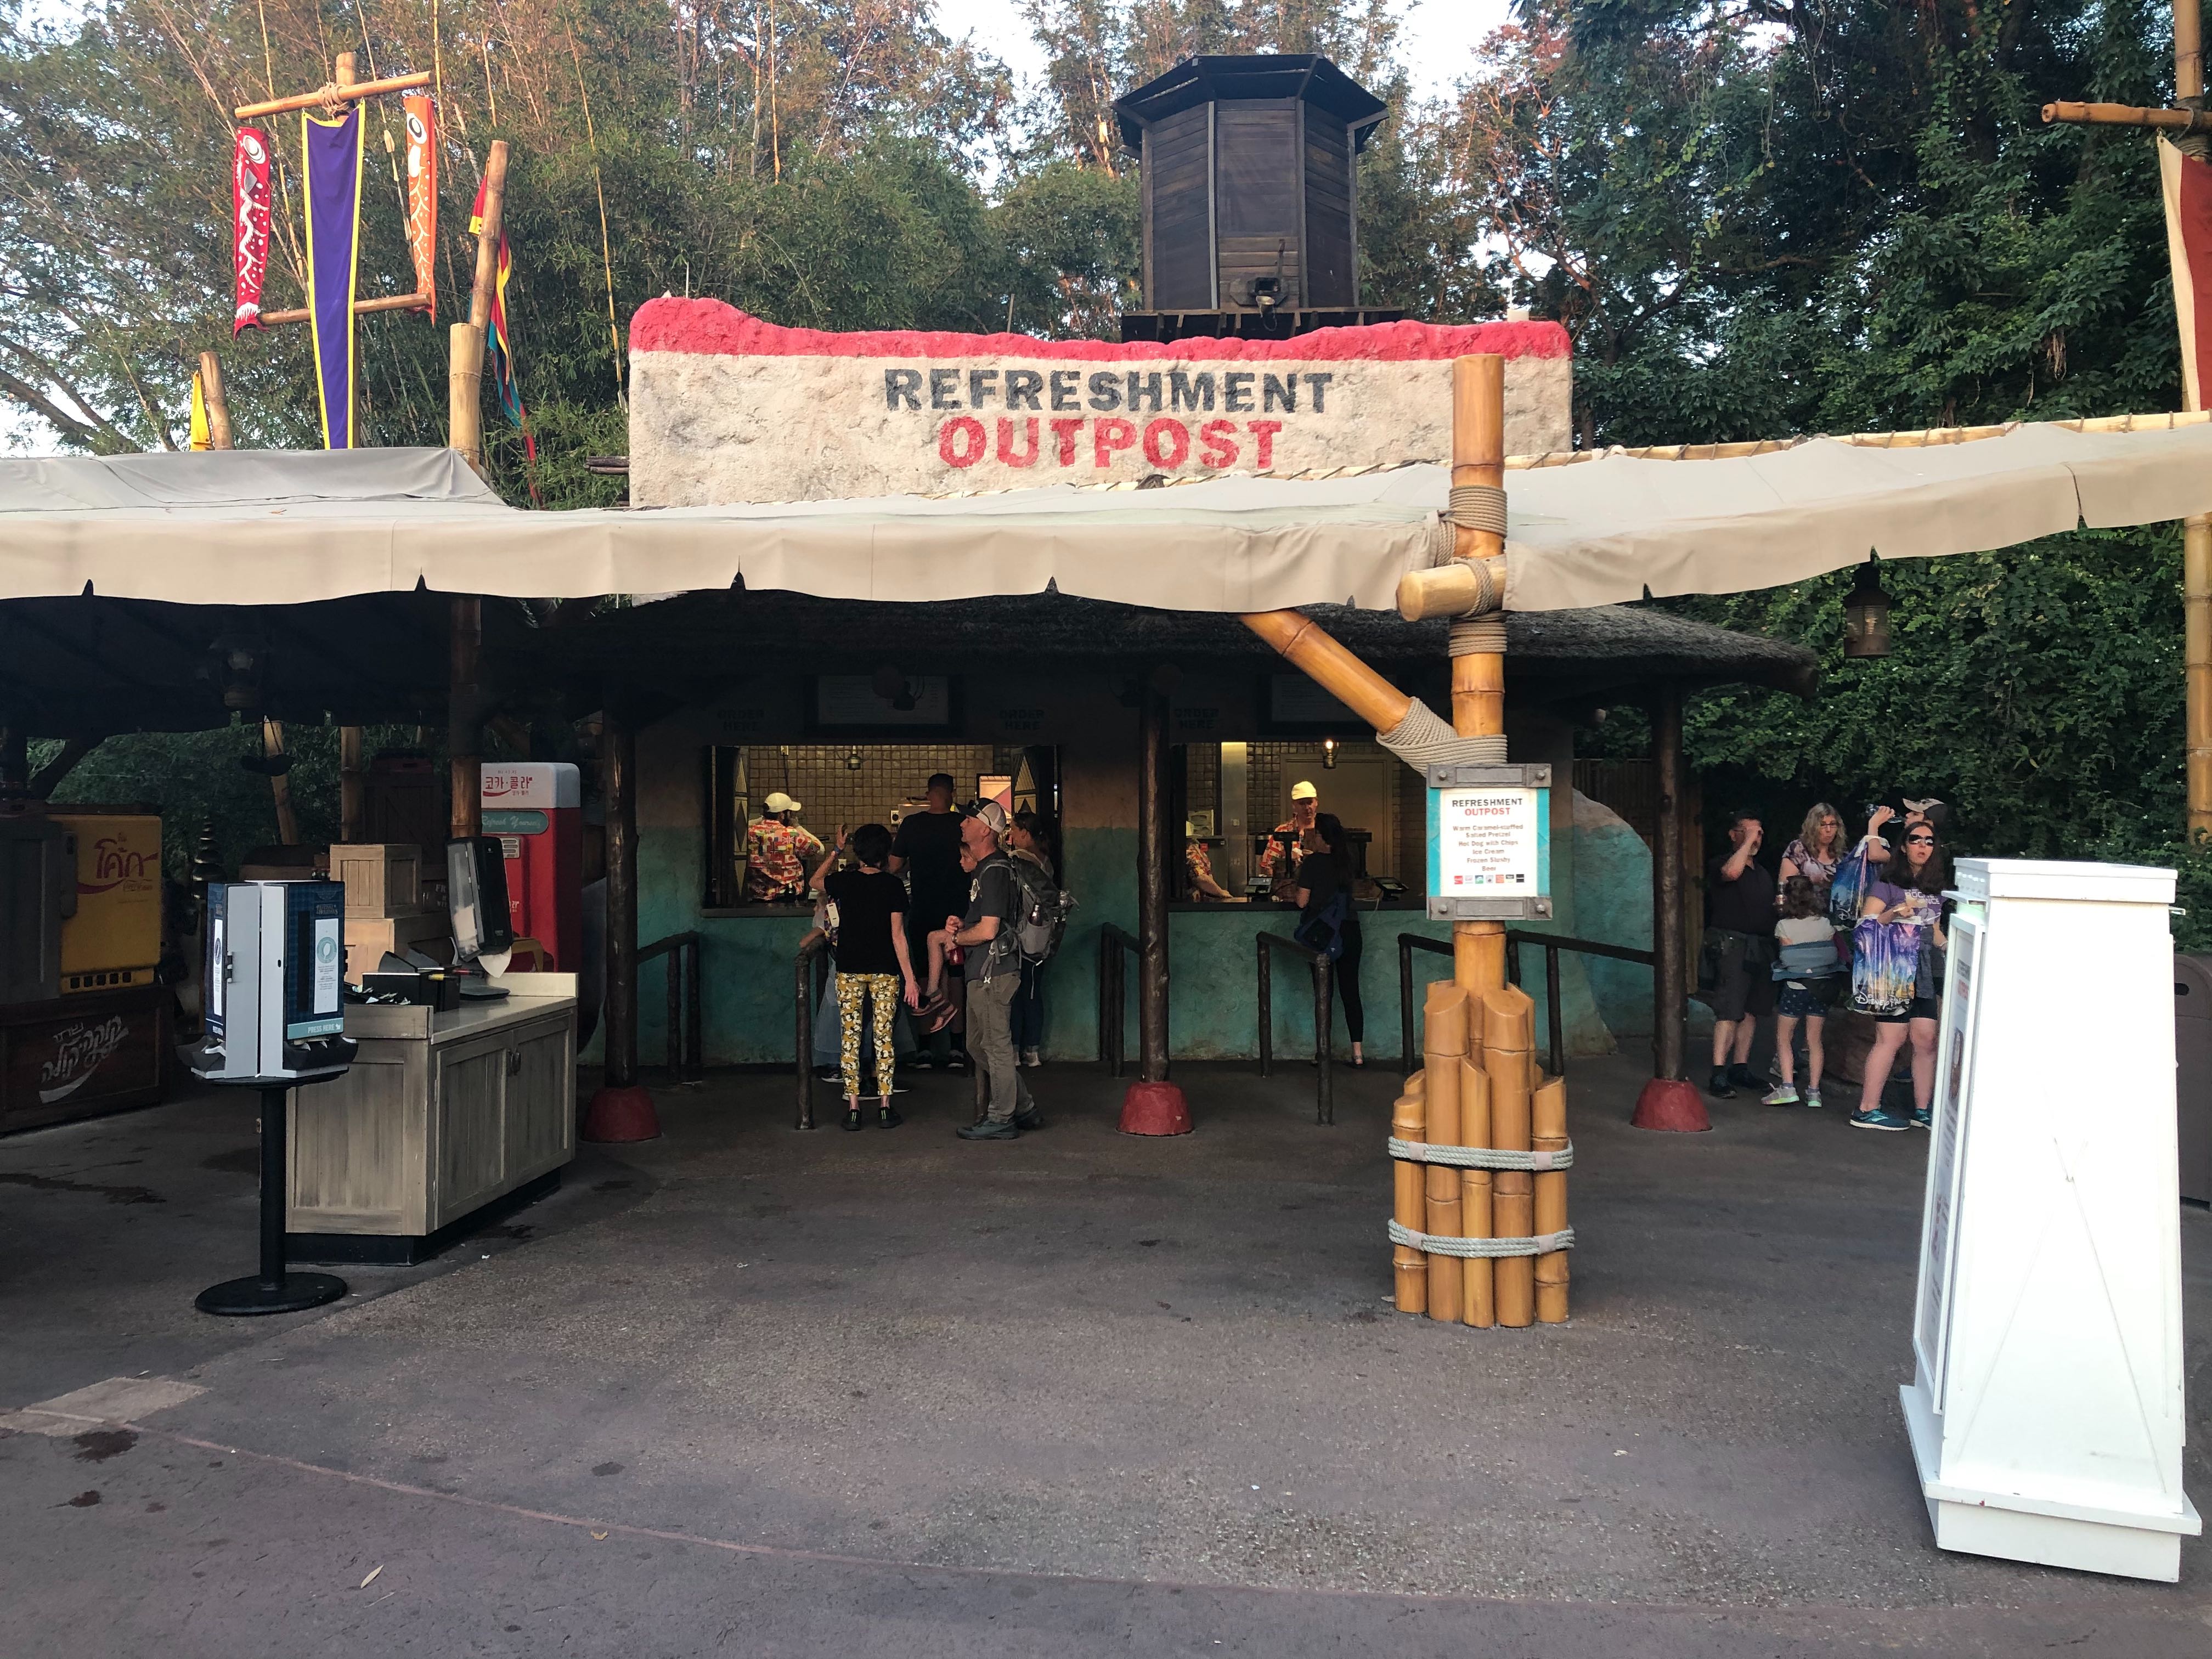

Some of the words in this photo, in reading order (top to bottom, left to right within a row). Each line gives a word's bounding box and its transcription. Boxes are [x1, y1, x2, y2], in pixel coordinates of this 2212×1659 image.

[884, 368, 1333, 414] REFRESHMENT
[938, 416, 1282, 470] OUTPOST
[1452, 798, 1523, 807] REFRESHMENT
[1465, 808, 1510, 816] OUTPOST
[307, 1025, 322, 1034] PRESS
